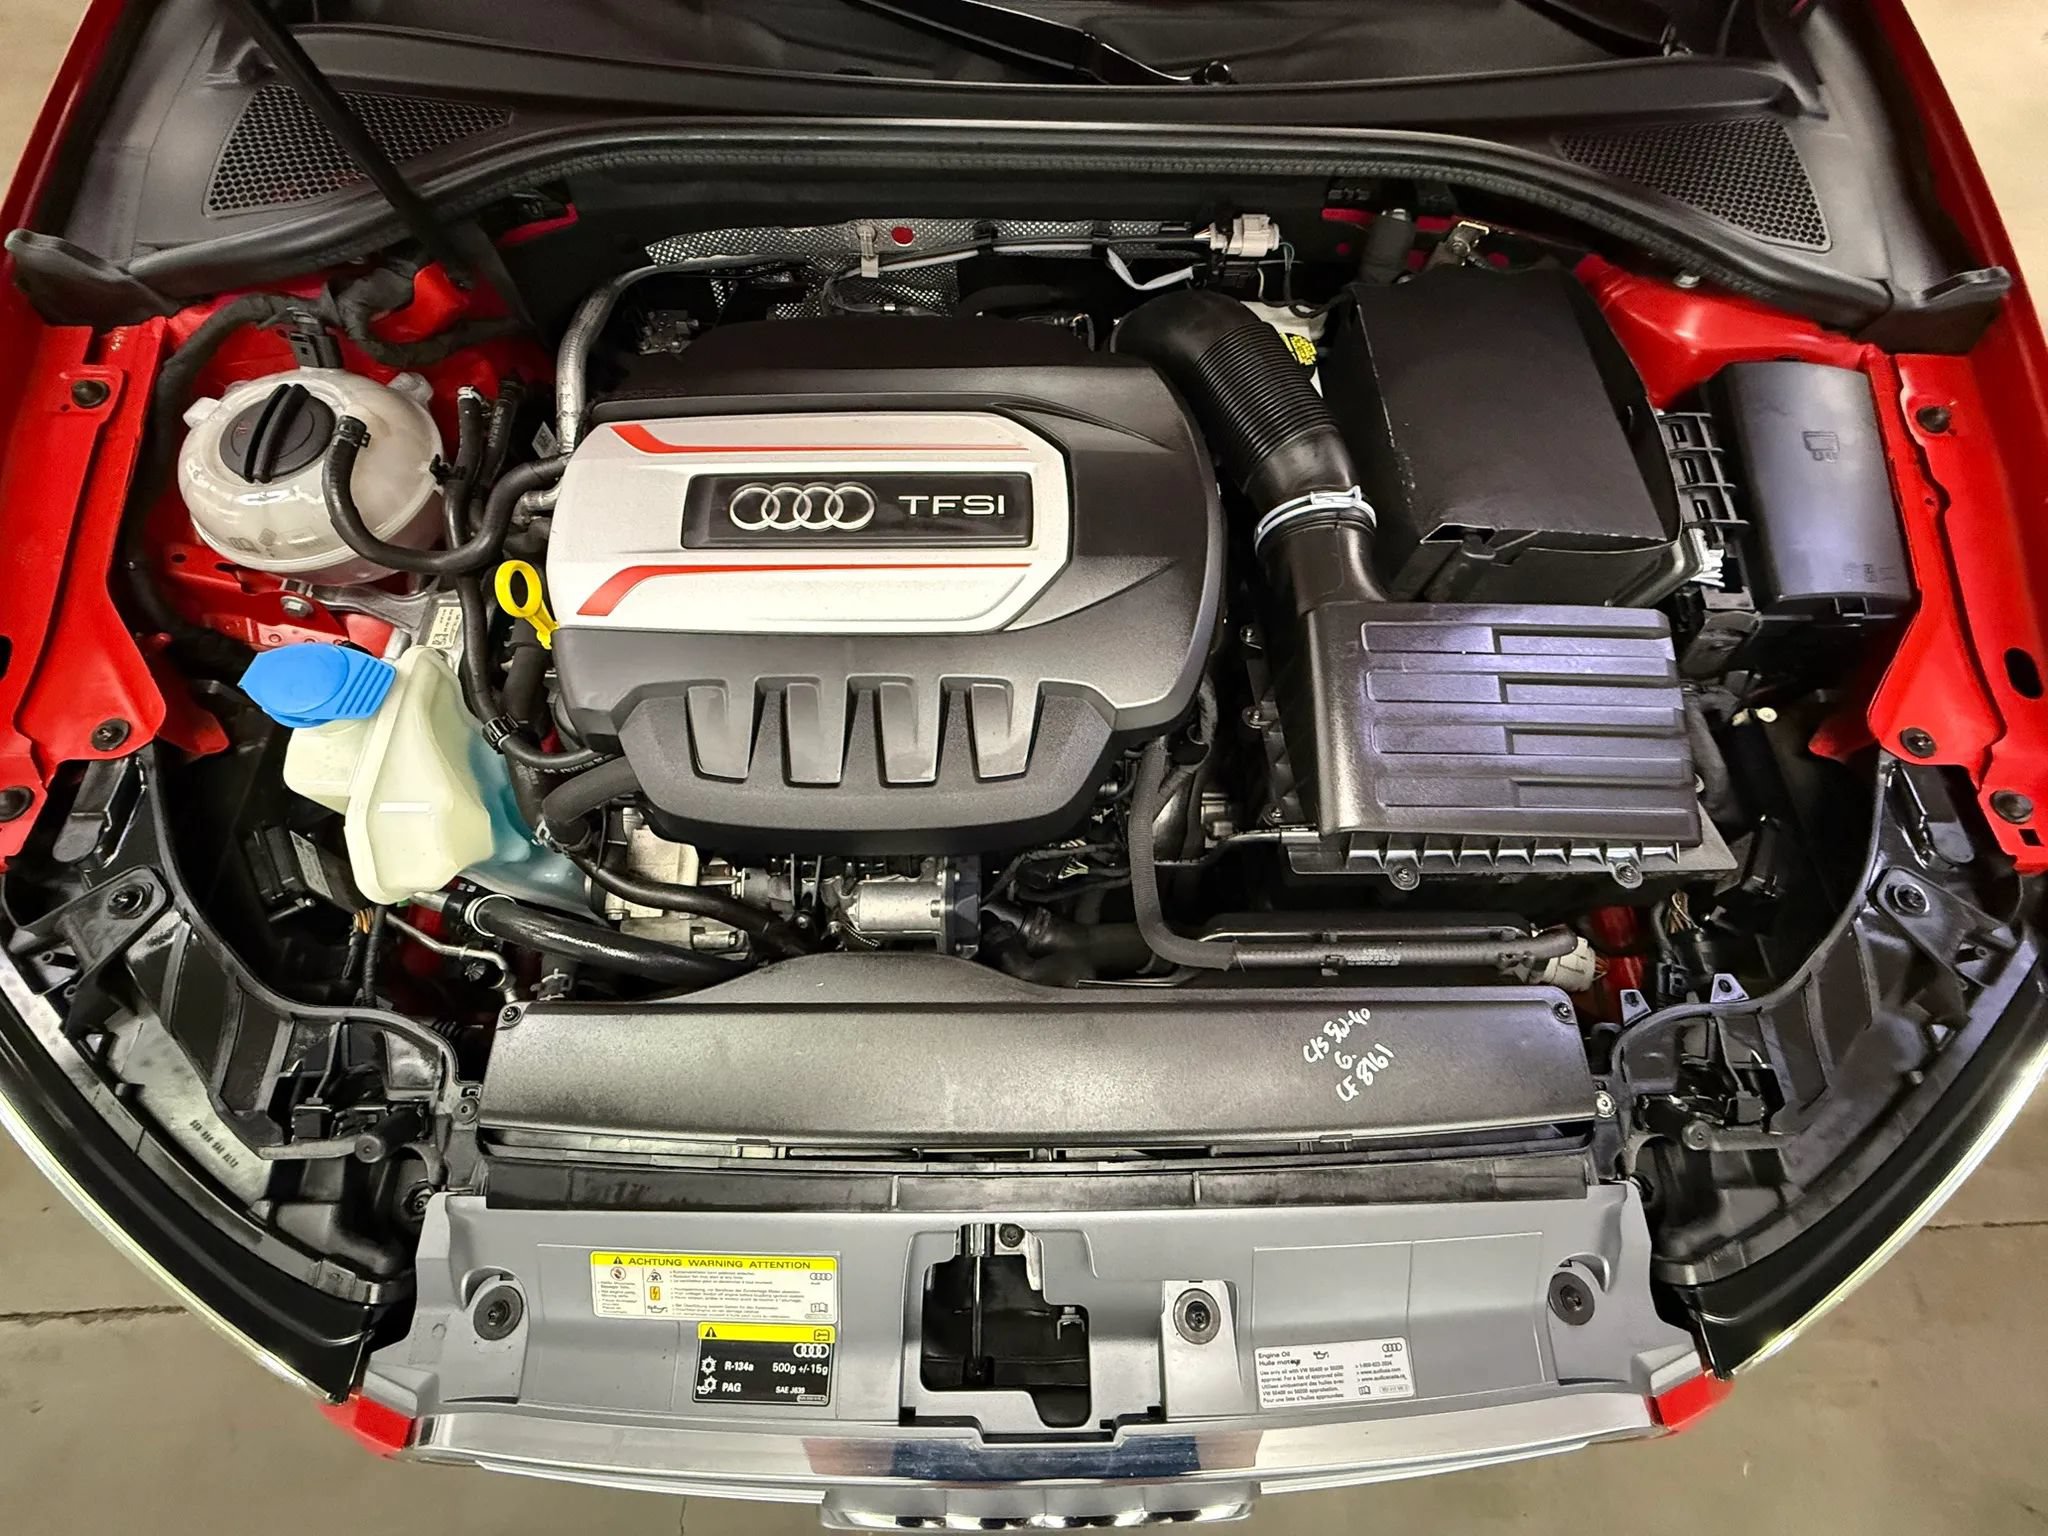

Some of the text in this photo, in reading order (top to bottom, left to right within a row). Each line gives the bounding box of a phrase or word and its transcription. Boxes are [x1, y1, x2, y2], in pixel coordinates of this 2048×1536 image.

[898, 494, 1005, 515] TFSI
[628, 1257, 811, 1270] ACHTUNG WARNING ATTENTION
[1258, 1352, 1280, 1360] Engine
[724, 1360, 754, 1372] R-134a
[772, 1362, 797, 1375] 500g
[721, 1382, 742, 1393] PAG
[775, 1386, 789, 1394] SAE
